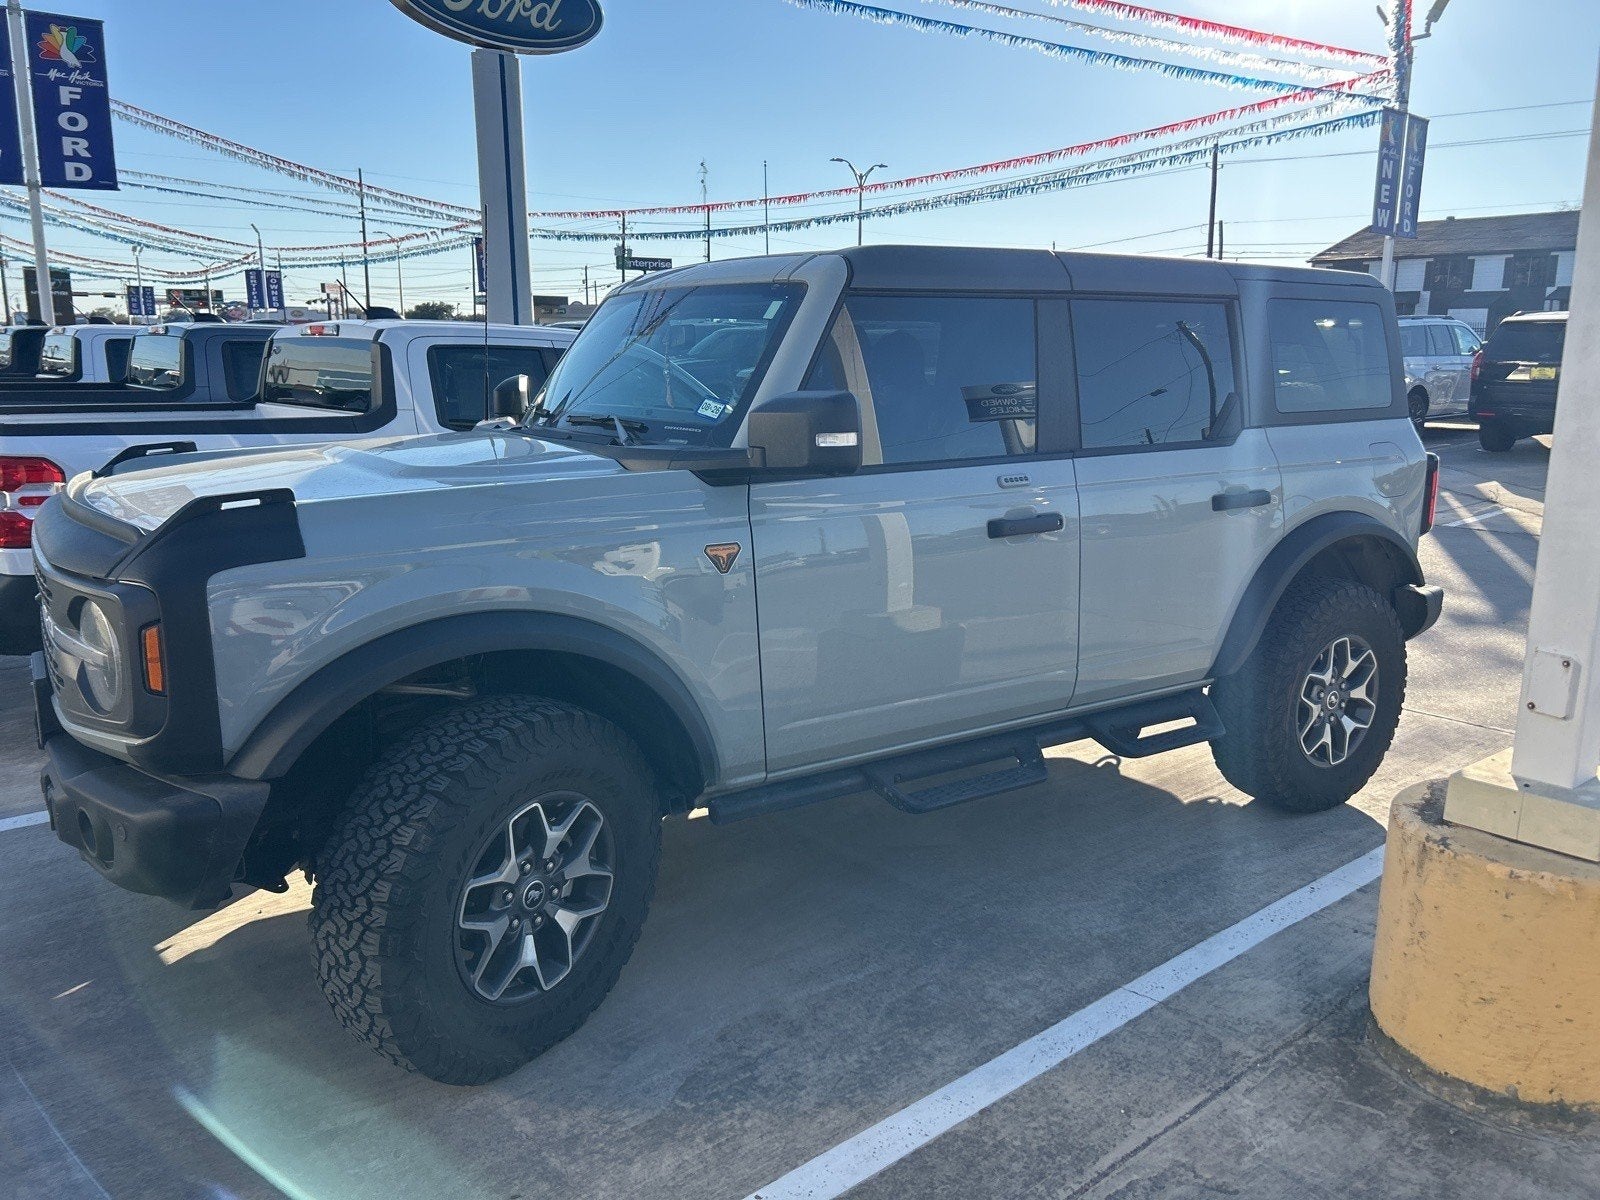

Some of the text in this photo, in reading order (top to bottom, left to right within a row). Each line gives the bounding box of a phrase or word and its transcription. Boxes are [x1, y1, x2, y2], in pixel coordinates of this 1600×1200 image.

[57, 85, 93, 182] FORD
[1377, 159, 1394, 228] NEW
[1403, 165, 1415, 233] FORD
[270, 278, 280, 307] OWNED
